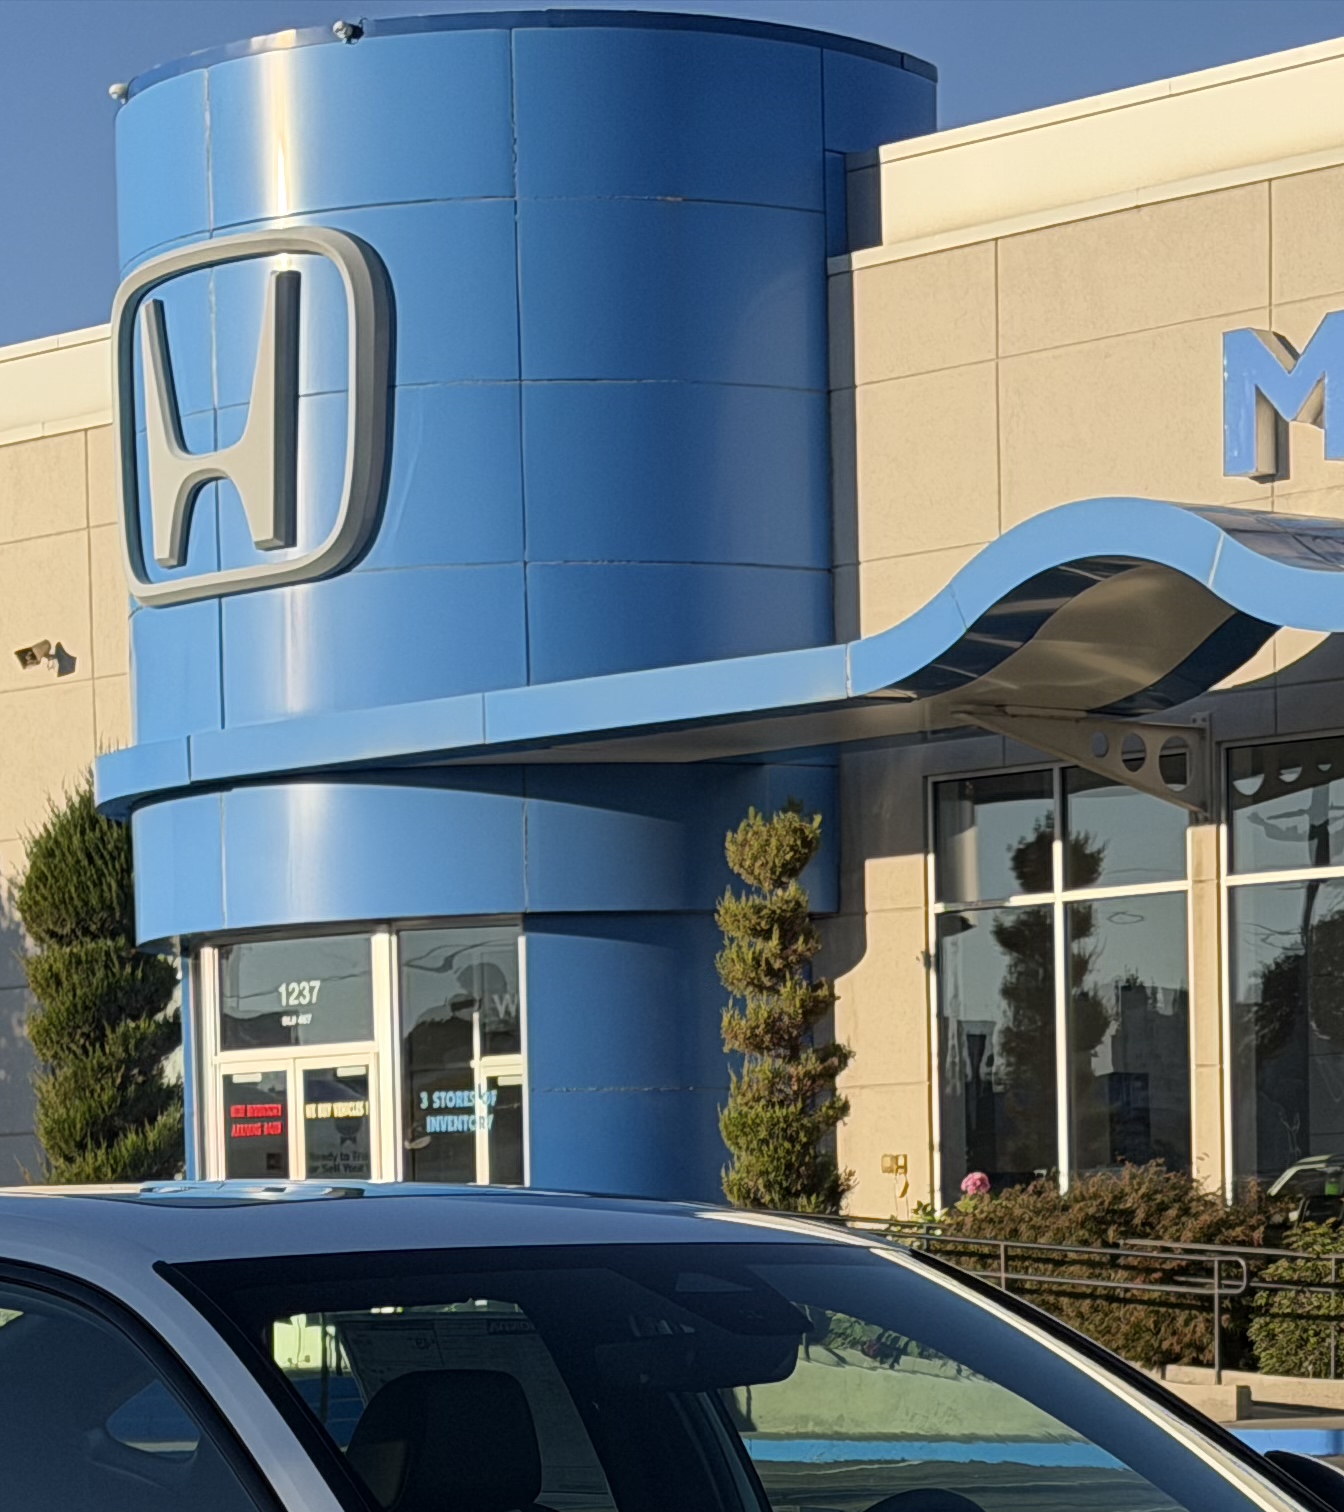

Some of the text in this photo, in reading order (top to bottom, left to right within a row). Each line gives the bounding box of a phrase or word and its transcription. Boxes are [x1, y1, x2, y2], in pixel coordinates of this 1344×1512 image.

[278, 979, 321, 1007] 1237
[419, 1090, 429, 1110] 3
[432, 1089, 477, 1109] STORES
[425, 1113, 494, 1133] INVENTORY
